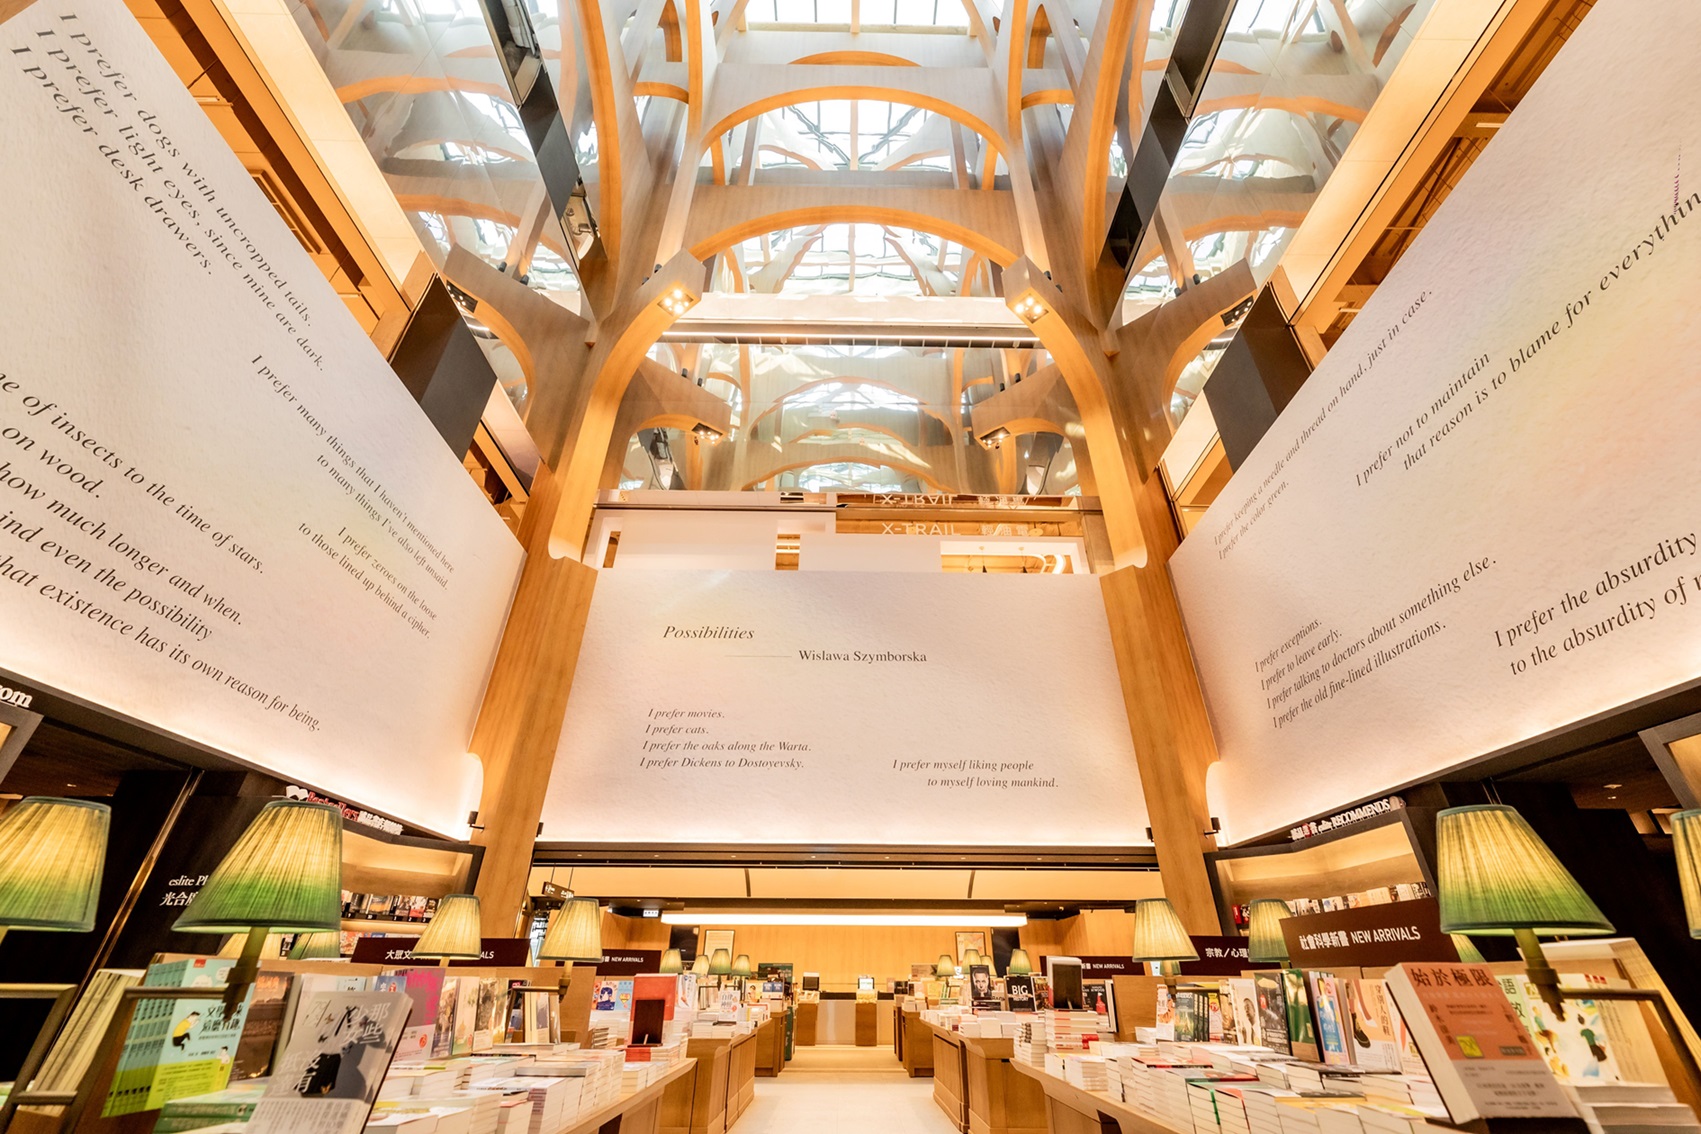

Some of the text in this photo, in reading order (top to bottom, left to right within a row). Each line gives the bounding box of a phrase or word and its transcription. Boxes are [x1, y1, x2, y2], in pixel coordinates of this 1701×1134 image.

[11, 46, 211, 274] I prefer desk drawers.
[69, 33, 136, 100] prefer
[137, 110, 179, 157] dogs
[182, 162, 215, 202] with
[216, 207, 287, 288] uncropped
[284, 291, 310, 326] tails.
[47, 49, 117, 117] prefer
[118, 125, 163, 172] light
[163, 180, 199, 226] eyes,
[204, 229, 242, 268] since
[243, 274, 275, 308] mine
[275, 313, 296, 333] are
[296, 338, 322, 371] dark.
[1300, 291, 1431, 444] thread on hand, just in case.
[1404, 443, 1426, 470] that
[1429, 403, 1472, 447] reason
[1474, 388, 1488, 404] is
[1491, 371, 1506, 389] to
[1509, 321, 1559, 372] blame
[1566, 290, 1591, 328] for
[1, 427, 103, 498] on wood.
[251, 355, 262, 363] I
[257, 366, 297, 402] prefer
[297, 404, 326, 435] many
[326, 435, 354, 467] things
[355, 467, 374, 487] that
[373, 484, 381, 492] I
[406, 521, 442, 559] mentioned
[440, 554, 454, 573] here
[1363, 445, 1392, 483] prefer
[1396, 425, 1413, 448] not
[1416, 413, 1428, 428] to
[1431, 354, 1489, 414] maintain
[22, 396, 262, 573] of insects to the time of stars.
[317, 455, 328, 467] to
[329, 467, 355, 495] many
[355, 493, 380, 521] things
[397, 537, 413, 553] also
[413, 550, 426, 566] left
[425, 564, 448, 590] unsaid.
[882, 523, 961, 536] X-TRAIL
[40, 541, 91, 573] even
[93, 568, 126, 591] the
[123, 588, 212, 641] possibility
[46, 500, 106, 539] much
[108, 533, 168, 575] longer
[168, 575, 204, 597] and
[203, 593, 241, 625] when.
[1494, 630, 1502, 647] I
[1506, 607, 1554, 646] prefer
[1560, 590, 1588, 613] the
[1595, 533, 1696, 596] absurdity
[39, 584, 133, 634] existence
[134, 626, 167, 652] has
[168, 644, 190, 664] its
[191, 660, 223, 681] own
[224, 675, 268, 703] reason
[264, 695, 288, 712] for
[288, 704, 319, 731] being.
[663, 625, 755, 639] Possibilities
[798, 649, 927, 664] Wislawa Szymborska
[1265, 667, 1285, 690] prefer
[1286, 661, 1294, 672] to
[1295, 646, 1315, 666] leave
[1317, 629, 1342, 651] early.
[1271, 686, 1292, 709] prefer
[1293, 669, 1320, 691] talking
[1321, 662, 1330, 673] to
[1332, 639, 1365, 667] doctors
[1367, 617, 1396, 644] about
[1399, 577, 1460, 623] something
[1463, 557, 1496, 581] else.
[1278, 706, 1299, 728] prefer
[1300, 698, 1312, 711] the
[1314, 685, 1328, 703] old
[1329, 658, 1372, 699] fine-lined
[1373, 621, 1445, 667] illustrations.
[1510, 659, 1526, 675] to
[1531, 645, 1556, 666] the
[1563, 598, 1655, 651] absurdity
[1664, 576, 1687, 605] of
[639, 756, 804, 770] I prefer Dickens to Dostoyevsky.
[642, 740, 812, 752] I prefer the oaks along the Warta.
[645, 723, 652, 733] I
[651, 724, 684, 735] prefer
[647, 708, 725, 719] I prefer movies.
[899, 759, 931, 771] prefer
[933, 759, 968, 771] myself
[968, 759, 998, 771] liking
[1000, 760, 1034, 772] people
[927, 776, 1059, 789] to myself loving mankind.
[168, 875, 195, 886] eslite
[1350, 930, 1372, 944] NEW
[1373, 926, 1421, 943] ARRIVALS
[1410, 967, 1494, 987] 始於極限
[1012, 985, 1029, 996] BIG
